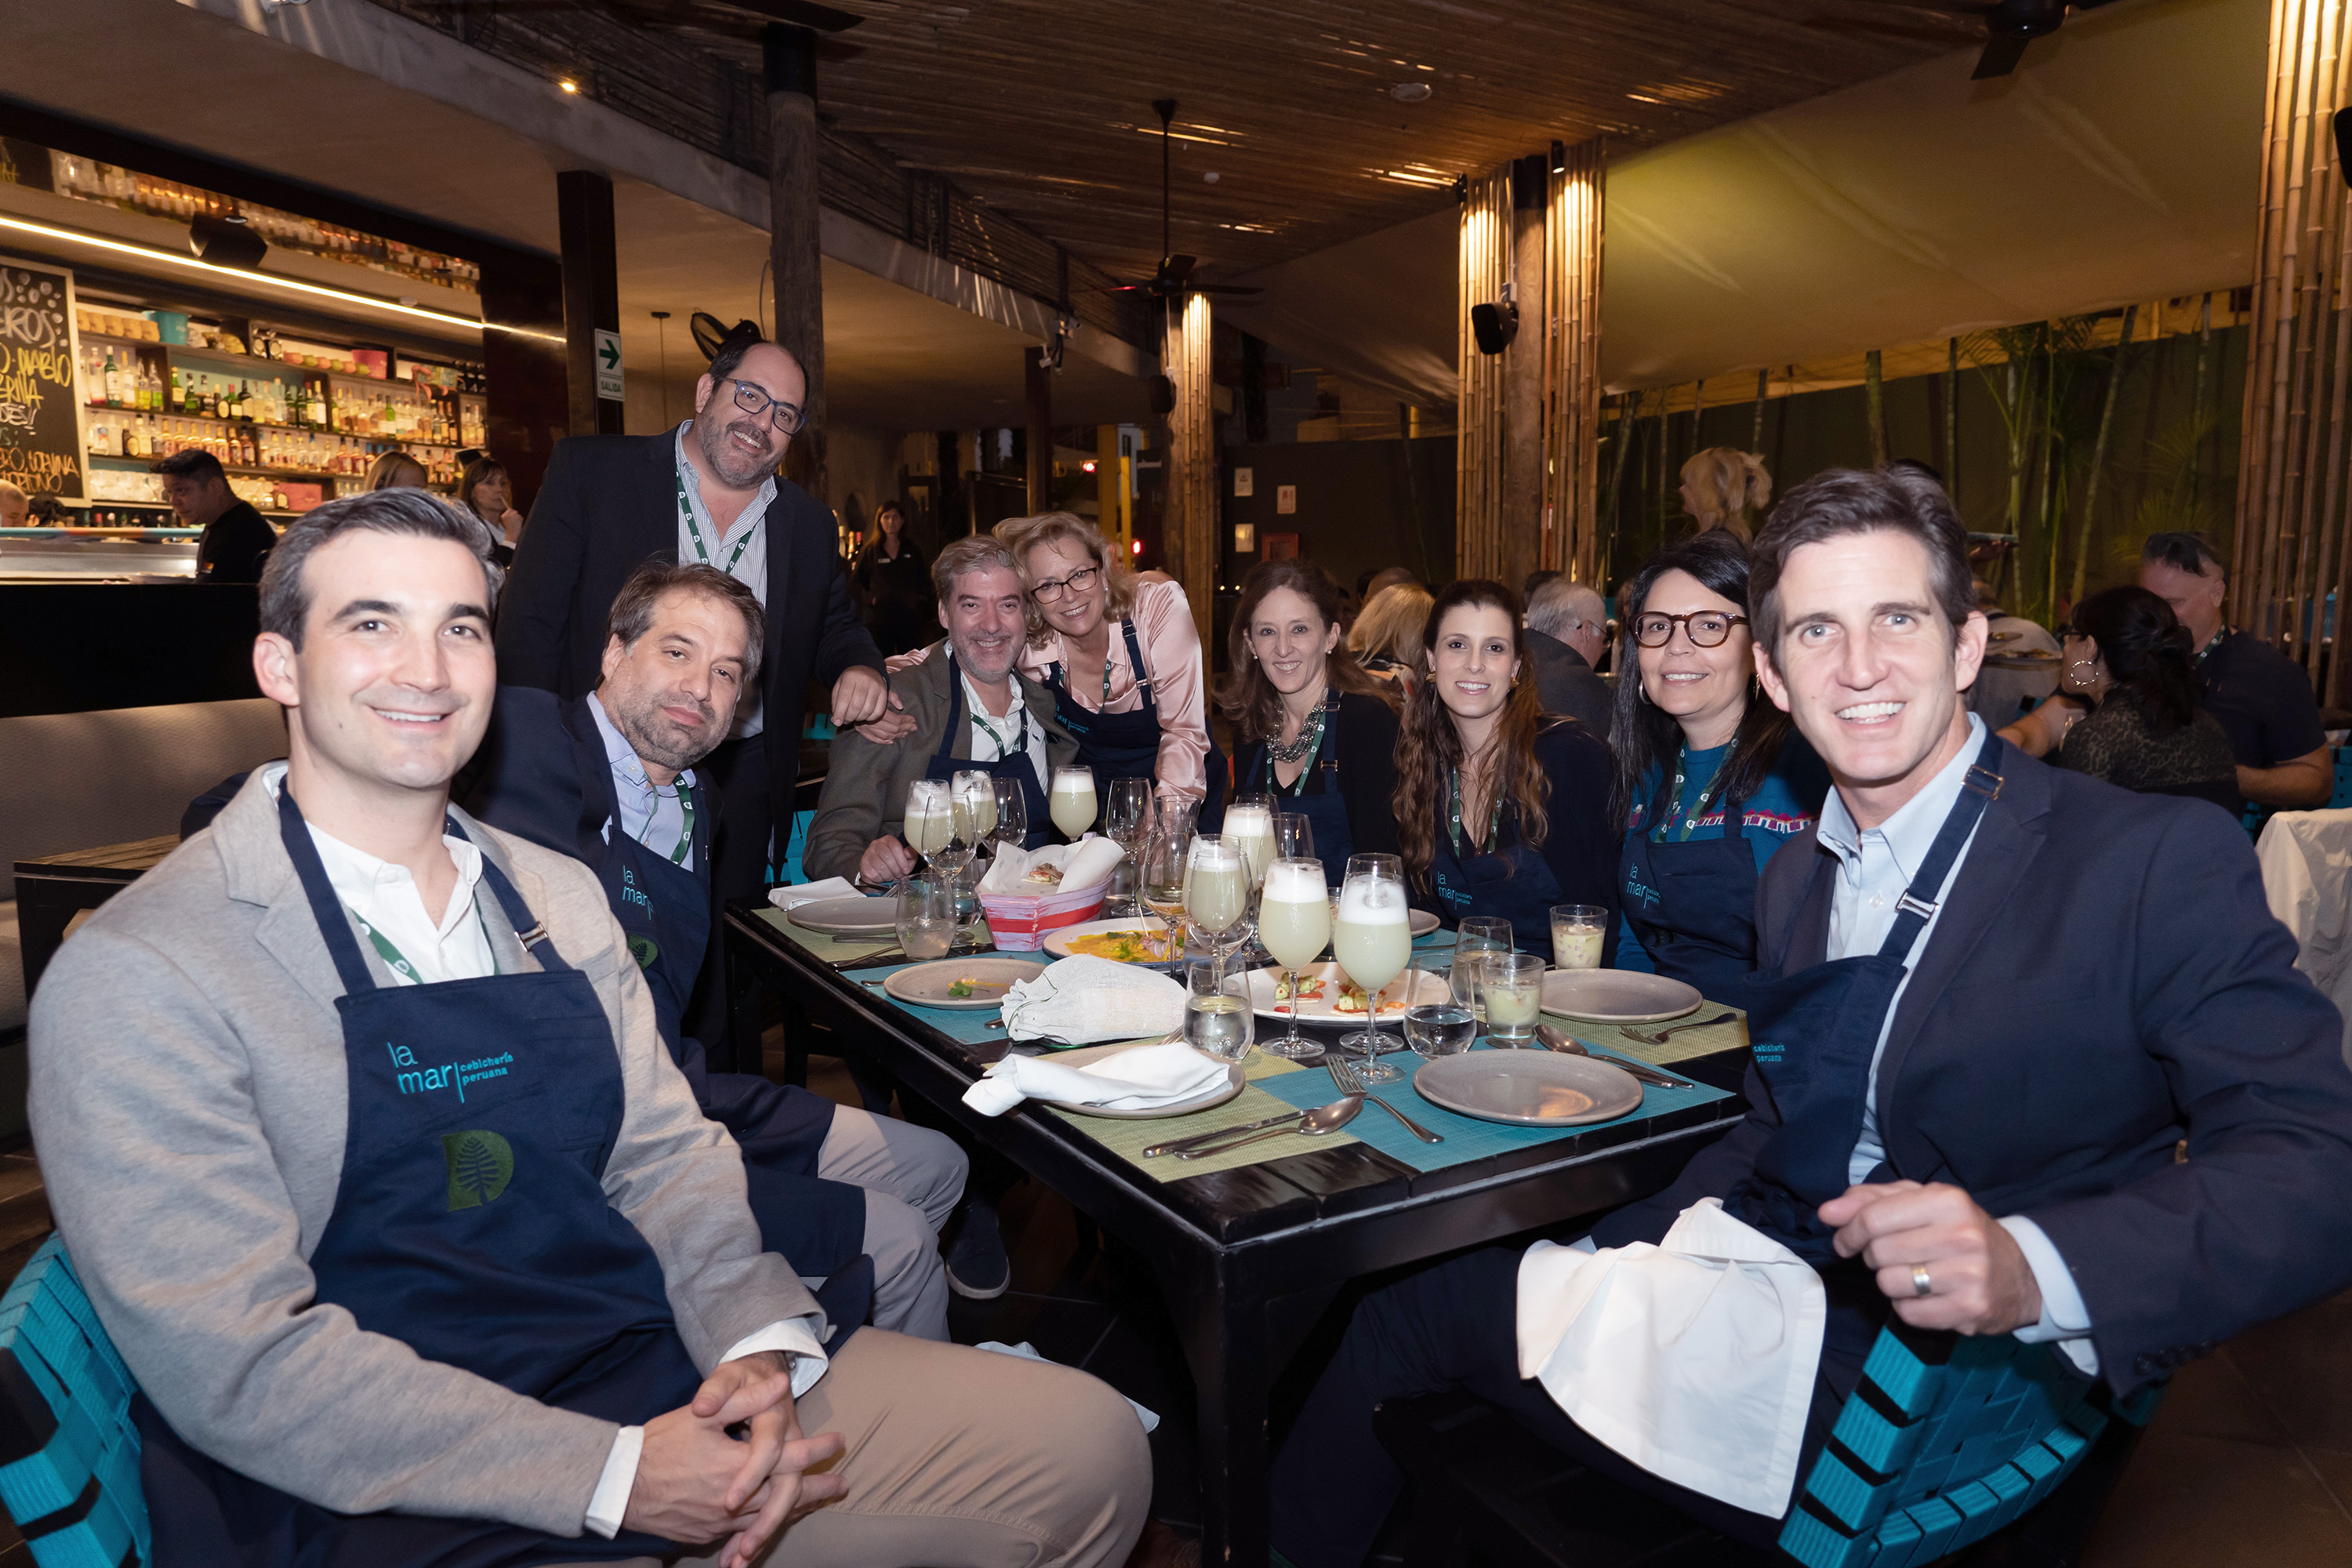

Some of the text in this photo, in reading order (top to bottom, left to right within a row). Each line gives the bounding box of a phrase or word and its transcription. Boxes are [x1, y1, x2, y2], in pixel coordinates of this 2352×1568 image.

[601, 381, 621, 393] SALIDA
[623, 865, 635, 886] la
[1437, 870, 1446, 884] la
[1630, 862, 1639, 879] la
[622, 886, 648, 906] mar
[1439, 886, 1454, 899] mar
[1626, 880, 1646, 897] mar
[387, 1042, 419, 1068] la
[397, 1065, 452, 1094] mar
[462, 1067, 508, 1086] peruana
